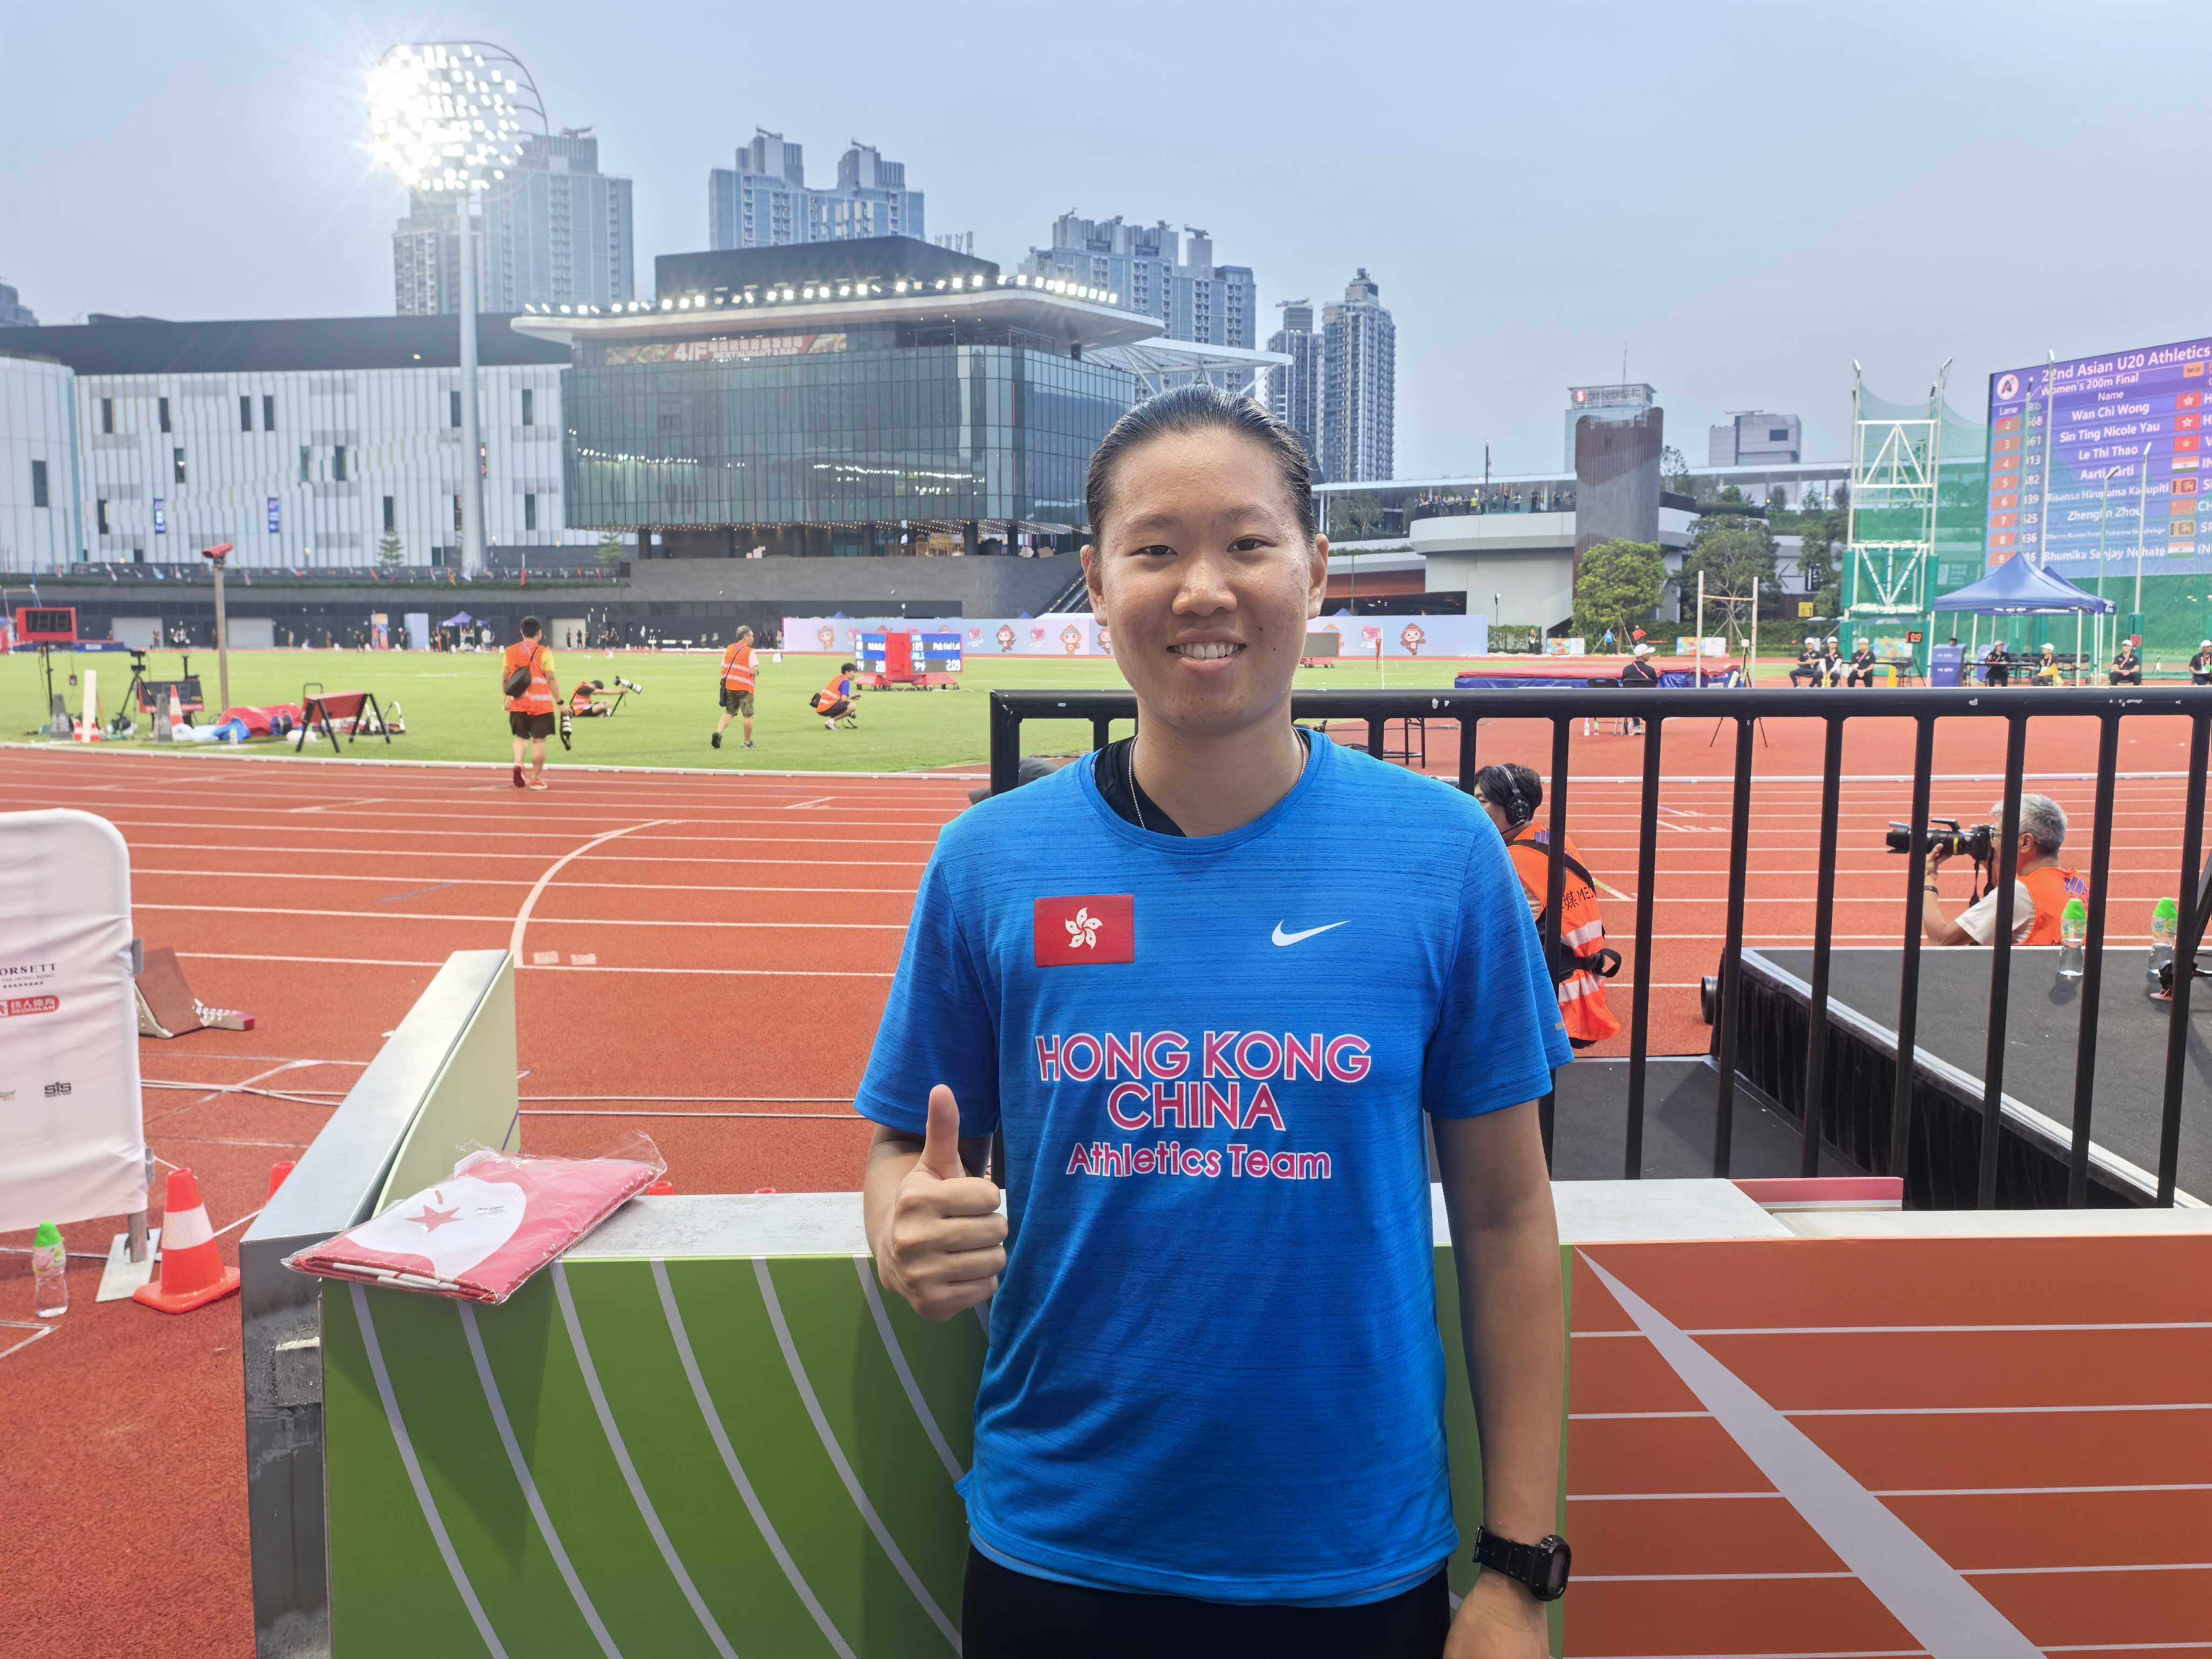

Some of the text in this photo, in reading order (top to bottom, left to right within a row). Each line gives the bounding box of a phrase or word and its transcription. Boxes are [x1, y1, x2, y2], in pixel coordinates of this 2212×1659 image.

[2077, 361, 2113, 377] Asian
[2117, 354, 2144, 370] U20
[2148, 345, 2212, 366] Athletics
[2086, 377, 2113, 389] 200m
[2115, 372, 2140, 385] Final
[1999, 407, 2018, 416] Lane
[2098, 391, 2124, 401] Name
[2072, 411, 2095, 421] Wan
[2098, 406, 2114, 418] Chi
[2117, 403, 2149, 415] Wong
[2004, 439, 2011, 449] 3
[2060, 432, 2075, 442] Sin
[2078, 429, 2100, 441] Ting
[2103, 423, 2137, 437] Nicole
[2140, 422, 2160, 433] Yau
[2003, 458, 2009, 468] 4
[2079, 450, 2090, 460] Le
[2093, 447, 2109, 458] Thi
[2112, 446, 2138, 456] Thao
[2002, 477, 2008, 488] 5
[2080, 468, 2105, 480] Aarti
[2001, 497, 2008, 507] 6
[2000, 516, 2007, 525] 7
[1999, 535, 2006, 545] 8
[1998, 554, 2005, 564] 9
[2044, 549, 2087, 561] Bhumika
[1035, 1031, 1372, 1083] HONG KONG
[1108, 1081, 1286, 1131] CHINA
[1065, 1141, 1331, 1180] Athletics Team
